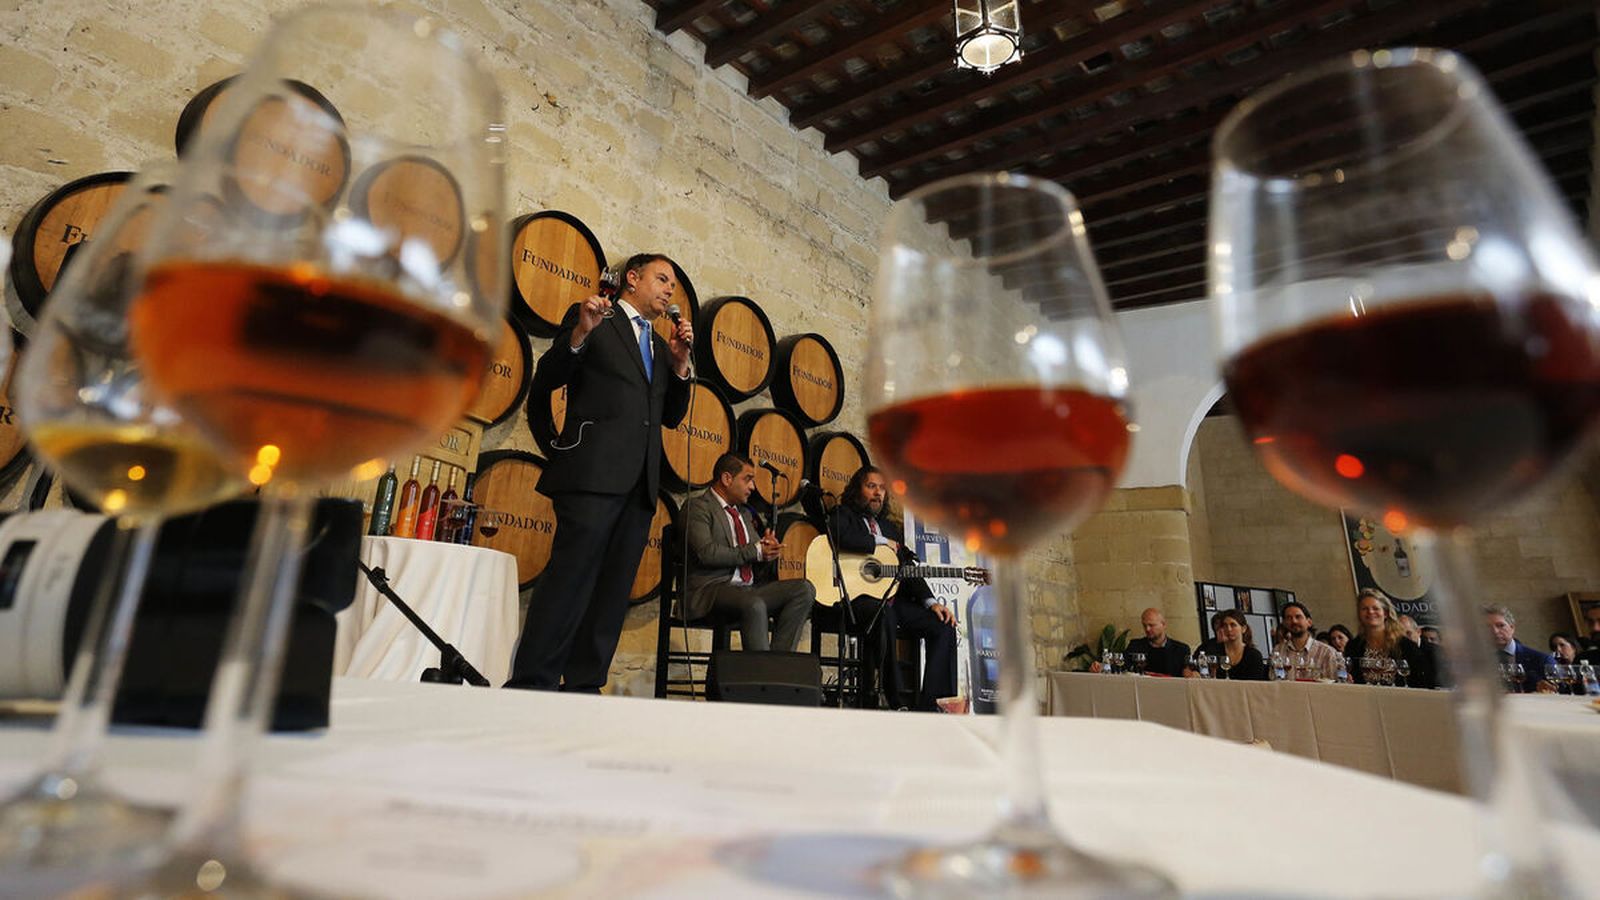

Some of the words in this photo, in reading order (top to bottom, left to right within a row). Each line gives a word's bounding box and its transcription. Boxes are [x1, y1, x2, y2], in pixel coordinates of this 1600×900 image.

[522, 248, 592, 289] FUNDADOR
[716, 330, 764, 361] FUNDADOR
[792, 364, 833, 391] FUNDADOR
[675, 422, 723, 445] UNDADOR
[752, 444, 799, 469] FUNDADOR
[931, 582, 960, 595] VINO
